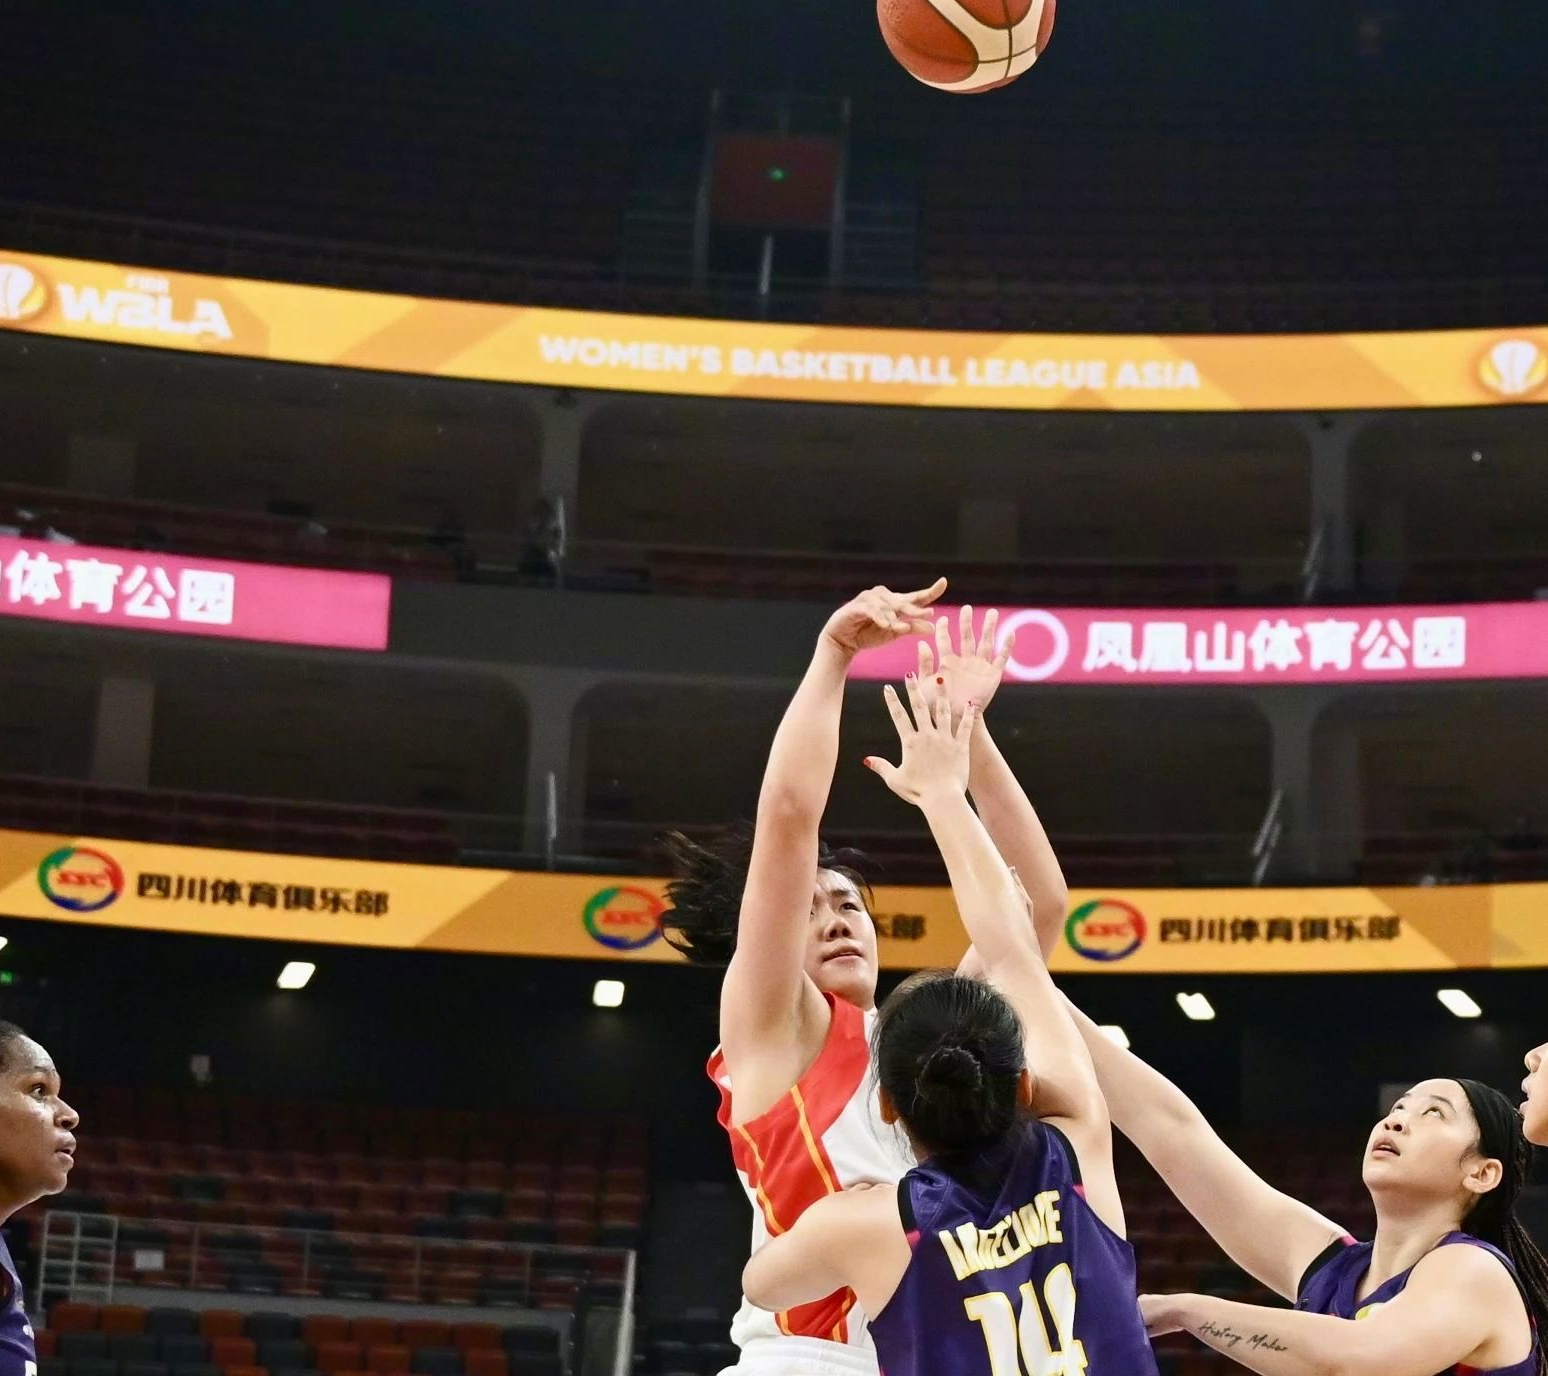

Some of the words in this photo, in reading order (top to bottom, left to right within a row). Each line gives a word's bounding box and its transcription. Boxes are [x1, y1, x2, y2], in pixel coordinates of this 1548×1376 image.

[54, 284, 232, 341] WBLA
[539, 334, 719, 376] WOMEN'S
[730, 343, 956, 387] BASKETBALL
[965, 354, 1105, 390] LEAGUE
[1114, 357, 1199, 391] ASIA
[1081, 614, 1466, 676] 凤凰山体育公园
[137, 871, 389, 917] 四川体育俱乐部
[1158, 912, 1402, 943] 四川体育俱乐部
